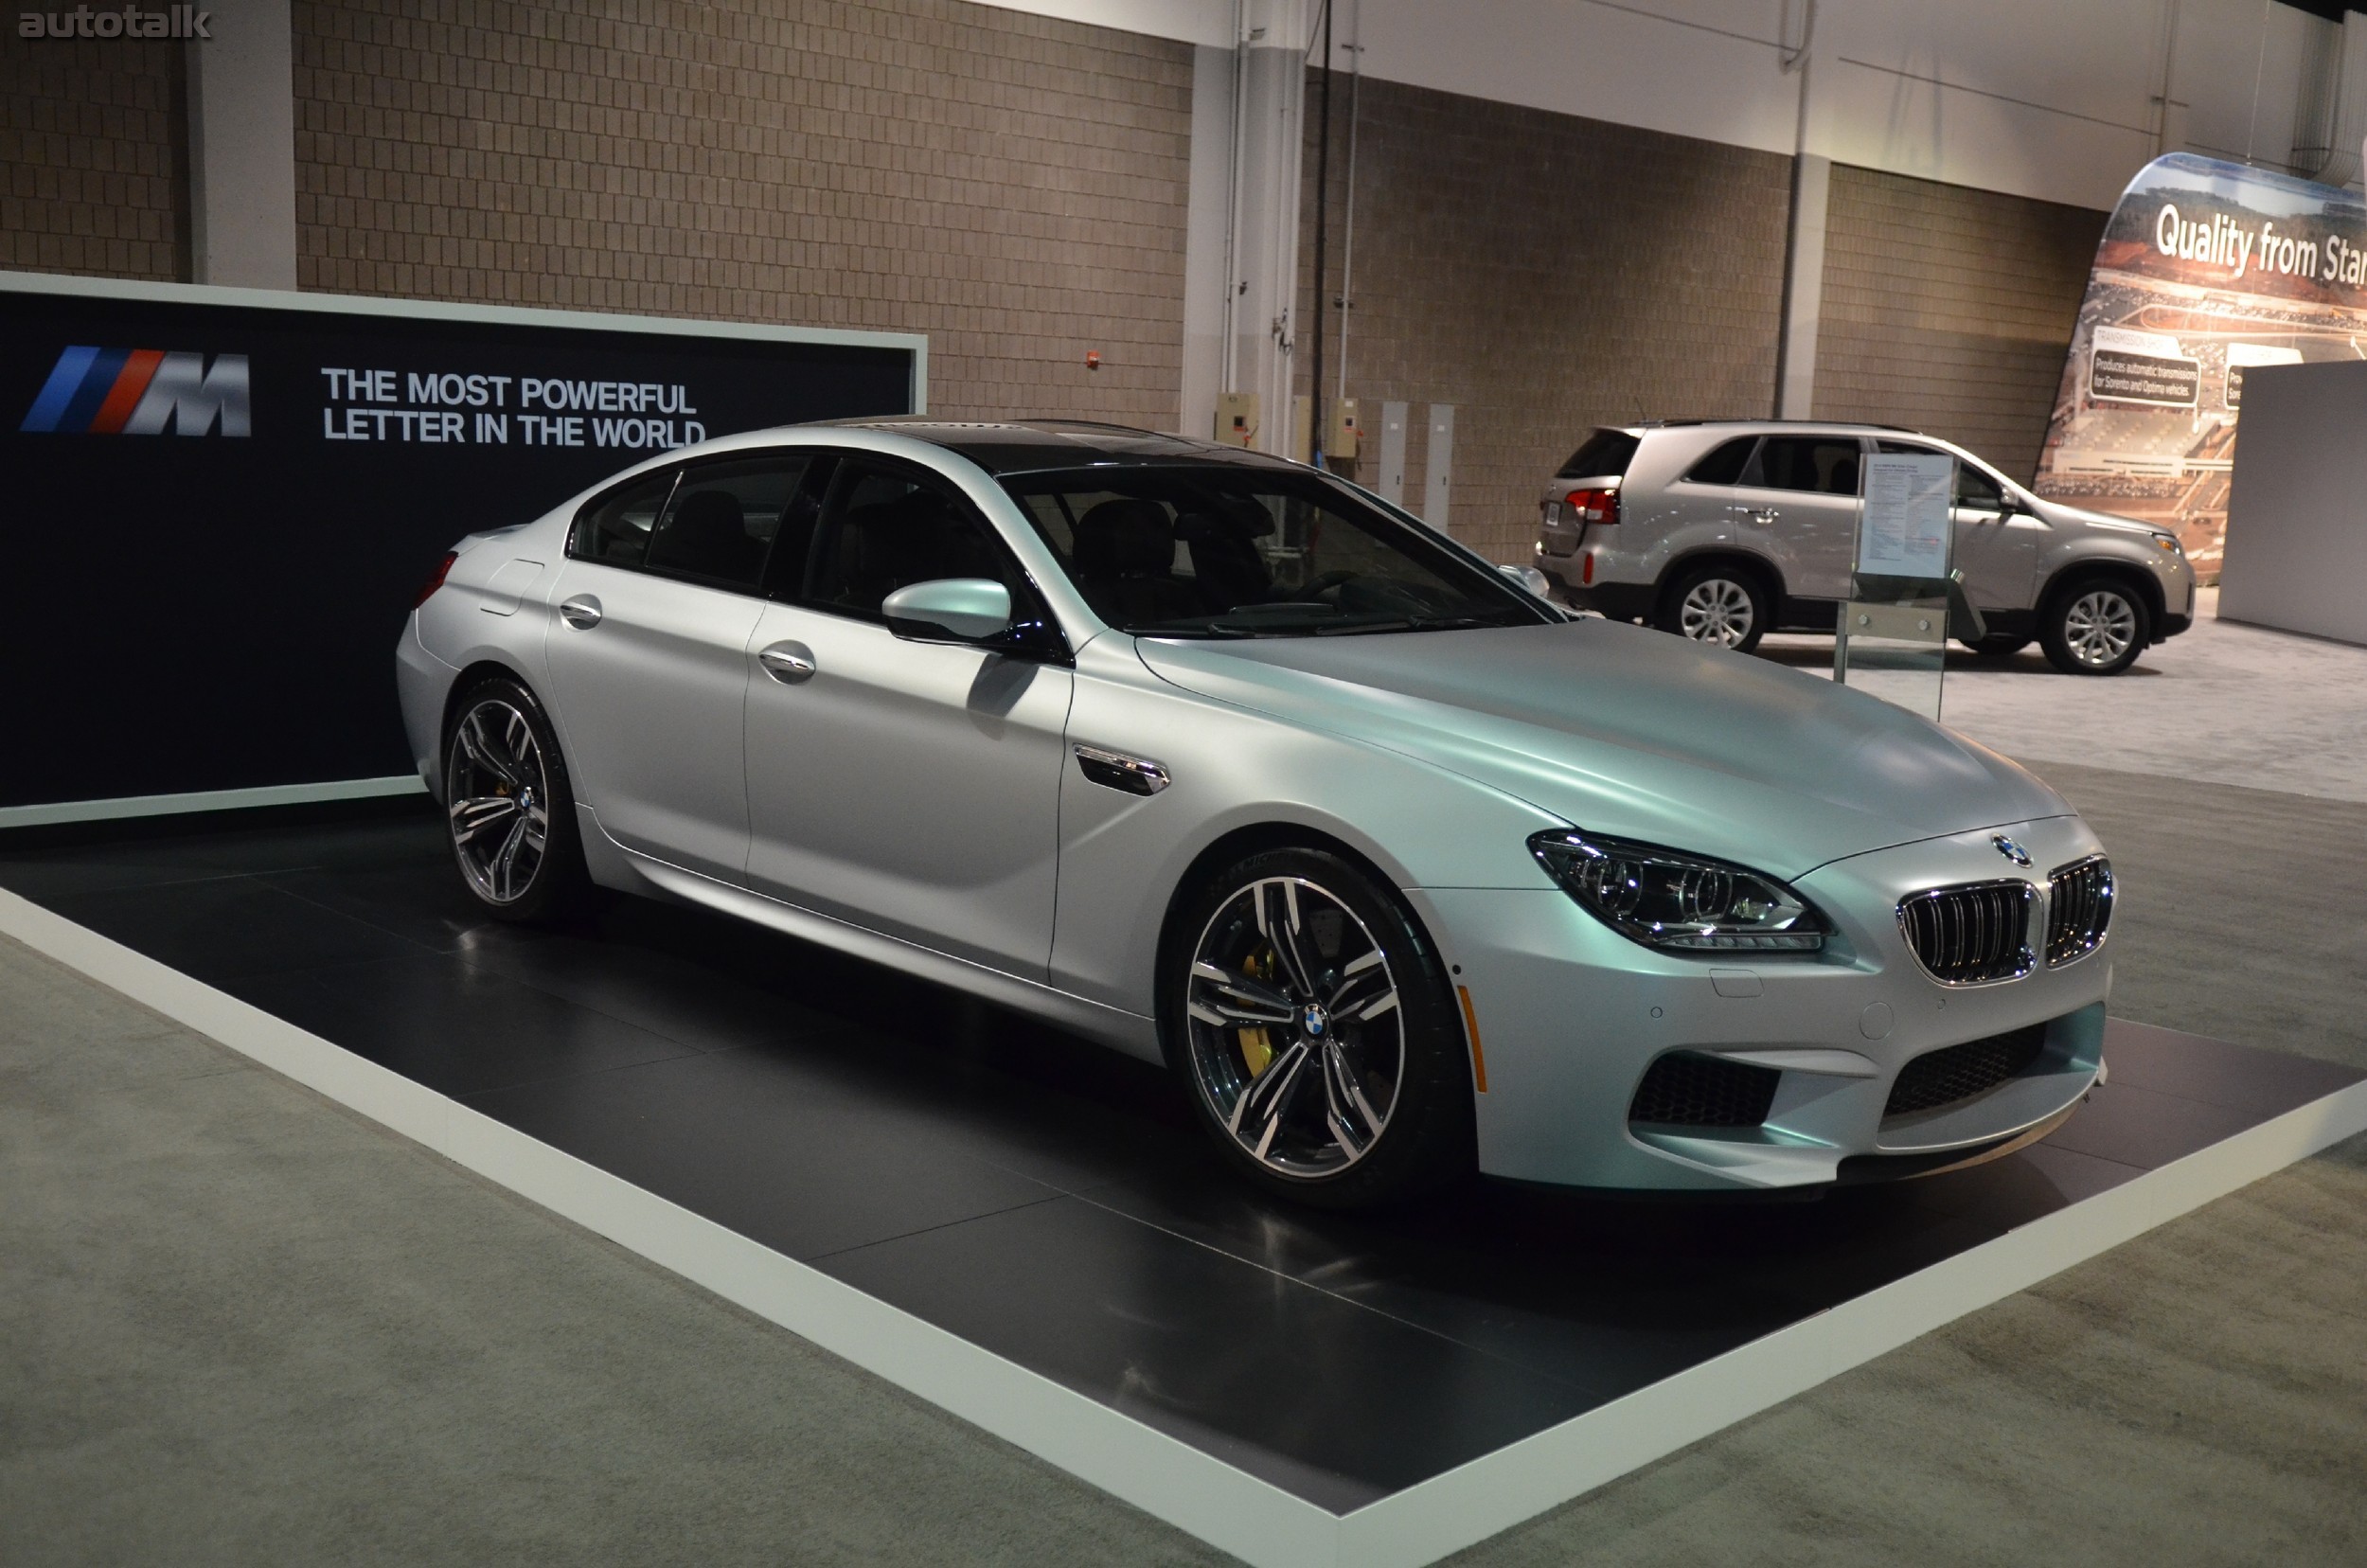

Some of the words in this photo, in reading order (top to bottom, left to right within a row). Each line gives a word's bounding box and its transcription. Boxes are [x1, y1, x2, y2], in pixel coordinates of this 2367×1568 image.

[2157, 205, 2253, 277] Quality
[2259, 222, 2317, 277] from
[2094, 374, 2105, 387] for
[2105, 376, 2129, 390] Sorento
[2129, 380, 2143, 393] and
[2143, 380, 2164, 395] Optima
[2095, 357, 2126, 373] Produces
[2127, 363, 2157, 377] automatic
[2158, 366, 2198, 381] transmissions
[321, 367, 398, 402] THE
[407, 373, 511, 407] MOST
[521, 377, 698, 414] POWERFUL
[324, 407, 465, 443] LETTER
[475, 413, 507, 444] IN
[517, 415, 585, 447] THE
[592, 418, 706, 449] WORLD
